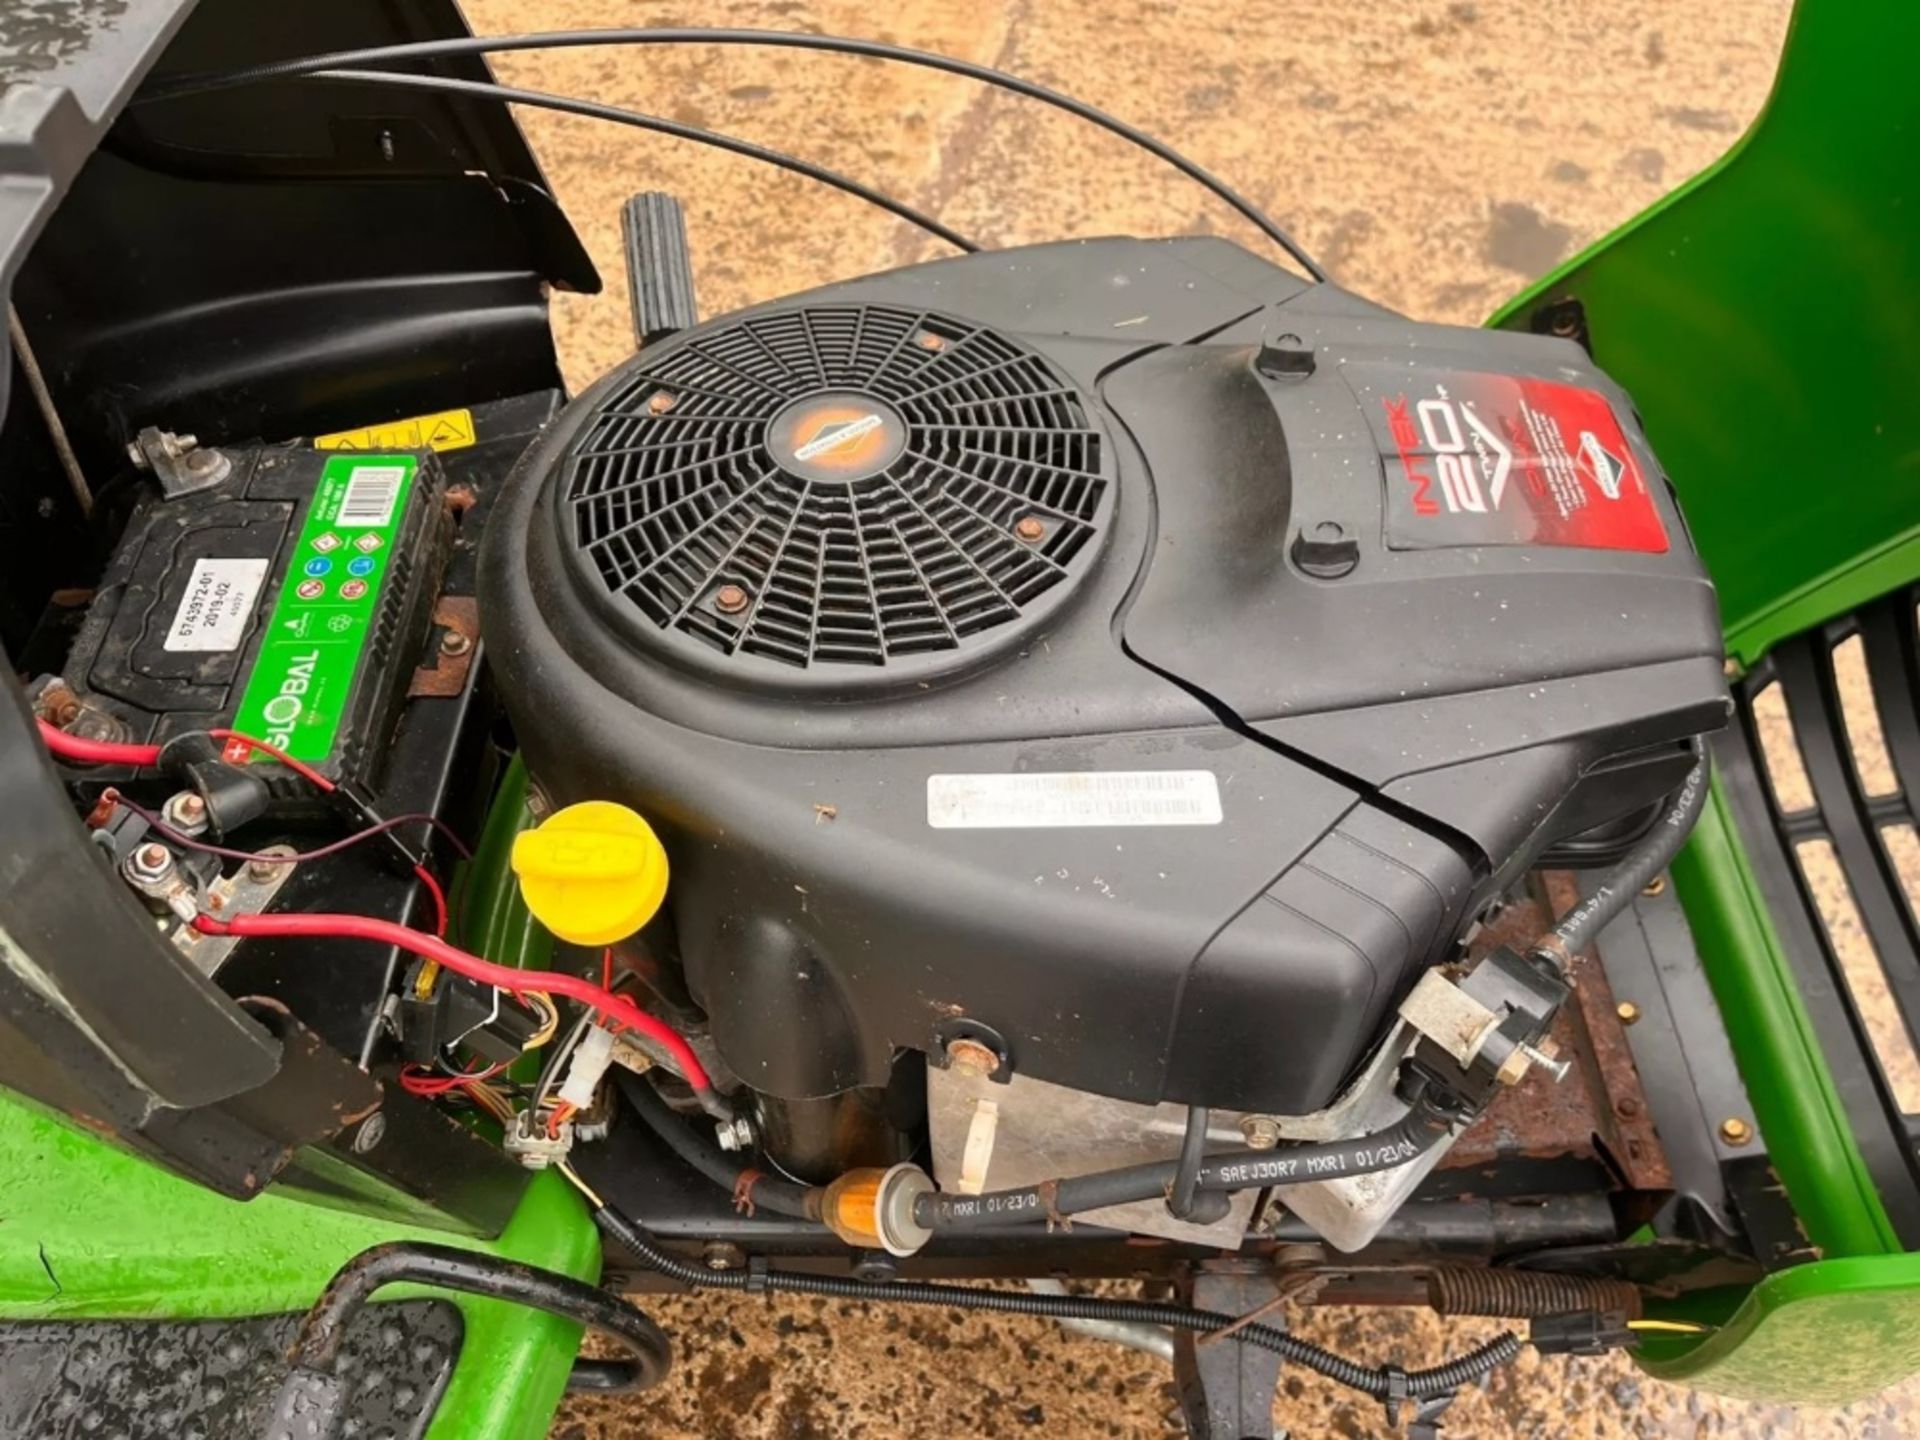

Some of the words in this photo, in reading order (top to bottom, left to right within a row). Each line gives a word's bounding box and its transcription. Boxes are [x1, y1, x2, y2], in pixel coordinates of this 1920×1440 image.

[1382, 394, 1441, 517] INTEK
[1416, 399, 1489, 513] 20
[1469, 431, 1493, 481] TWIN
[178, 571, 217, 637] 5743972-01
[202, 582, 231, 627] 2019-02
[262, 649, 319, 753] GLOBAL
[987, 1193, 1040, 1213] 01/23/0
